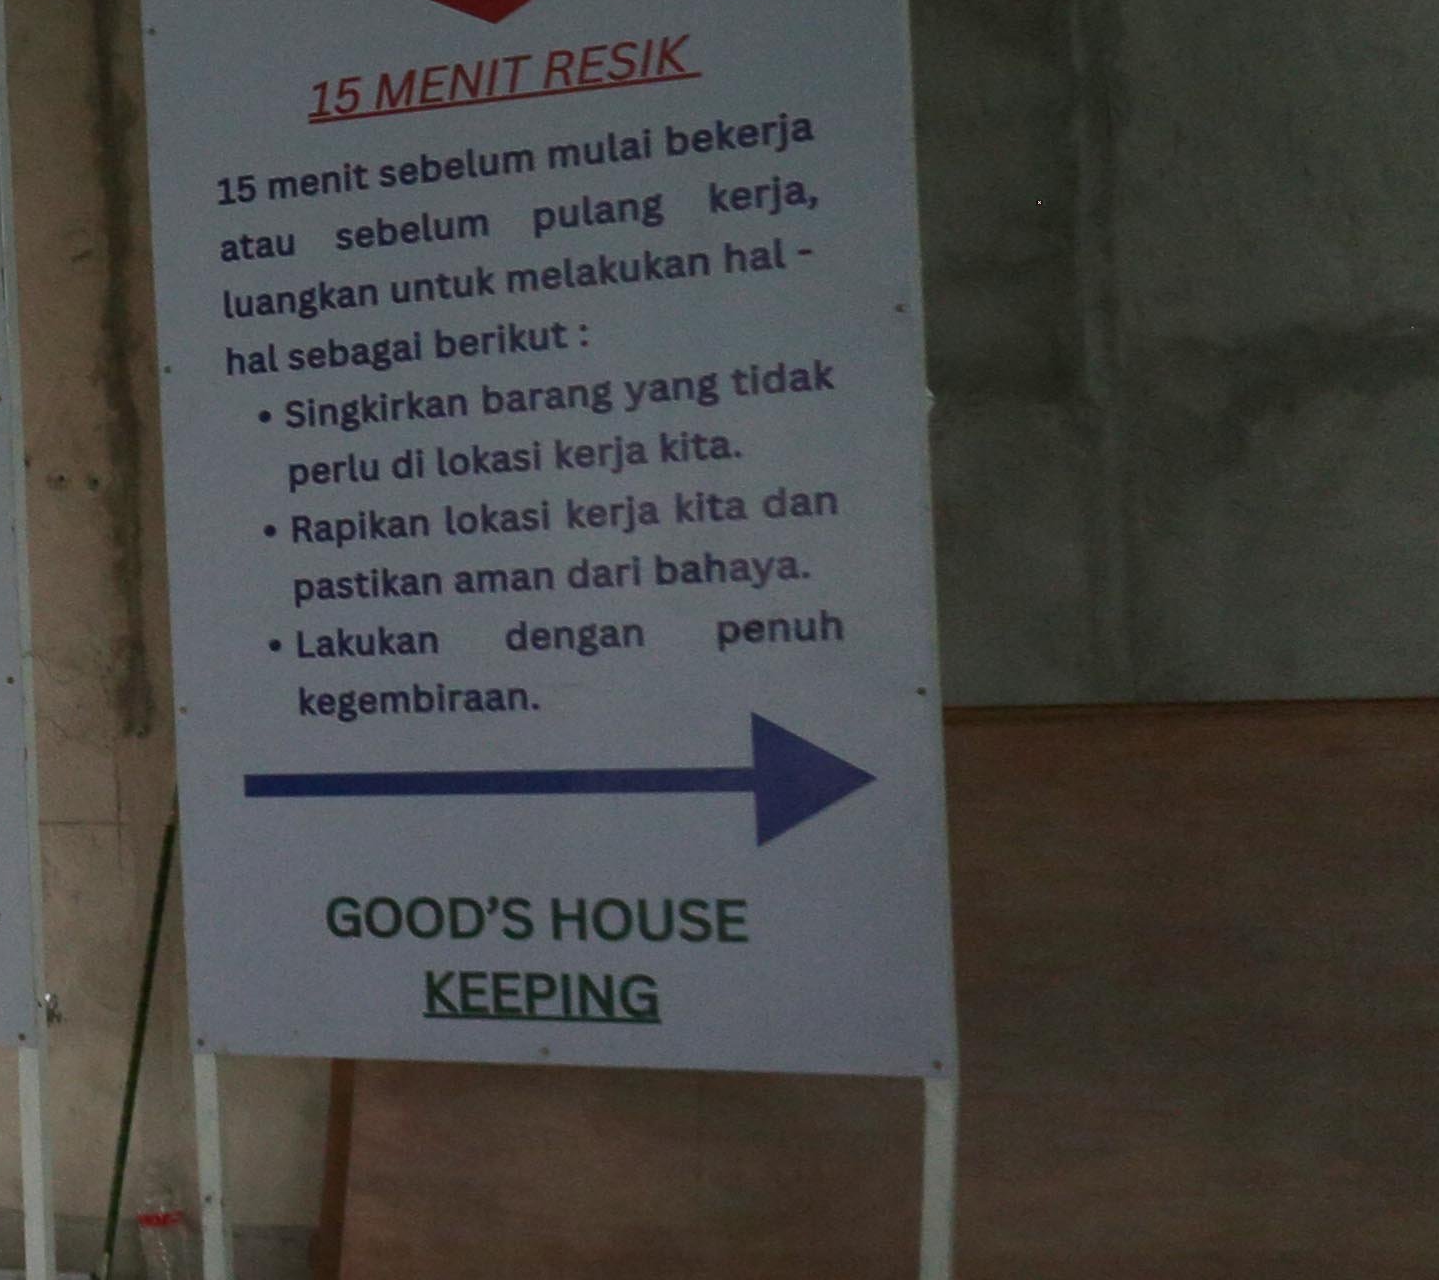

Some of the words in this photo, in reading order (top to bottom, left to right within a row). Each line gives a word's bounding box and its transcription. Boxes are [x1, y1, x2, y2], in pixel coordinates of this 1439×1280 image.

[310, 79, 360, 116] 15
[375, 54, 532, 110] MENIT
[543, 34, 691, 89] RESIK
[218, 175, 257, 206] 15
[268, 163, 369, 200] menit
[379, 148, 535, 187] sebelum
[548, 128, 652, 169] mulai
[665, 113, 815, 156] bekerja
[221, 234, 295, 262] atau
[336, 212, 489, 251] sebelum
[533, 194, 664, 238] pulang
[223, 281, 378, 319] luangkan
[391, 266, 495, 304] untuk
[507, 251, 710, 293] melakukan
[724, 238, 786, 273] hal
[226, 344, 279, 376] hal
[288, 331, 422, 371] sebagai
[434, 322, 568, 359] berikut
[285, 391, 468, 432] Singkirkan
[482, 381, 613, 414] barang
[624, 373, 720, 412] yang
[731, 360, 835, 396] tidak
[288, 453, 380, 493] perlu
[392, 449, 424, 479] di
[437, 441, 541, 477] lokasi
[555, 436, 648, 474] kerja
[660, 432, 742, 462] kita.
[292, 510, 429, 548] Rapikan
[445, 500, 550, 535] lokasi
[567, 496, 660, 534] kerja
[676, 492, 747, 523] kita
[763, 487, 838, 518] dan
[294, 568, 442, 608] pastikan
[455, 568, 554, 594] aman
[568, 556, 641, 589] dari
[655, 552, 810, 589] bahaya.
[297, 626, 438, 658] Lakukan
[505, 621, 644, 657] dengan
[717, 610, 844, 652] penuh
[298, 683, 540, 723] kegembiraan.
[551, 898, 749, 944] HOUSE
[424, 970, 661, 1018] KEEPING
